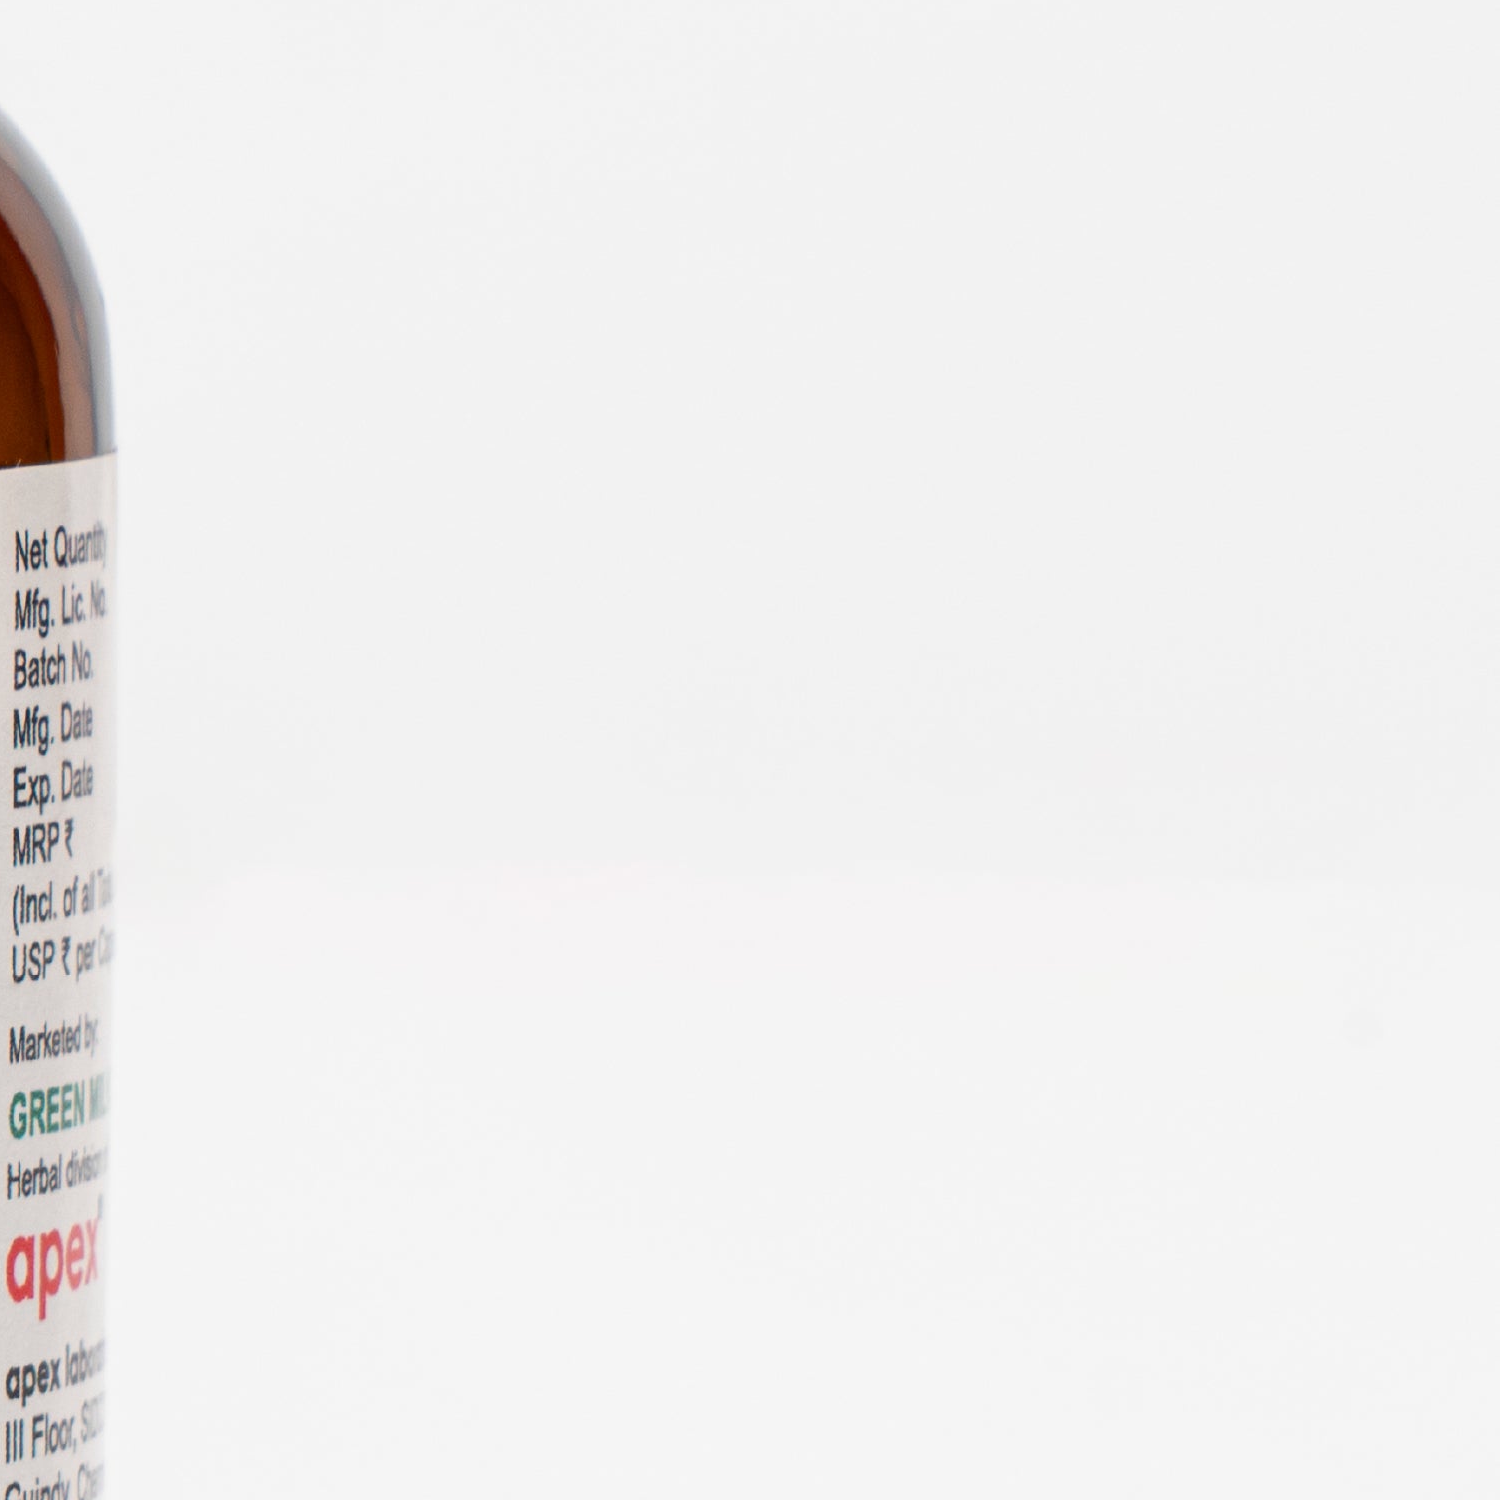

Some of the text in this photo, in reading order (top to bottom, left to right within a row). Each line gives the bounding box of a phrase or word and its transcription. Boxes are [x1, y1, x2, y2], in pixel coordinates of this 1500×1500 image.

[15, 529, 48, 573] Net
[15, 587, 55, 638] Mfg.
[61, 583, 86, 626] Lic.
[14, 640, 94, 691] Batch No.
[13, 700, 93, 756] Mfg. Date
[13, 759, 93, 815] Exp. Date
[13, 821, 59, 867] MRP
[12, 880, 57, 936] (Incl.
[63, 875, 79, 917] of
[12, 939, 56, 983] USP
[9, 1014, 82, 1064] Marketed
[9, 1079, 85, 1140] GREEN
[7, 1153, 62, 1200] Herbal
[6, 1357, 61, 1408] apex
[5, 1418, 24, 1464] III
[32, 1411, 77, 1459] Floor,
